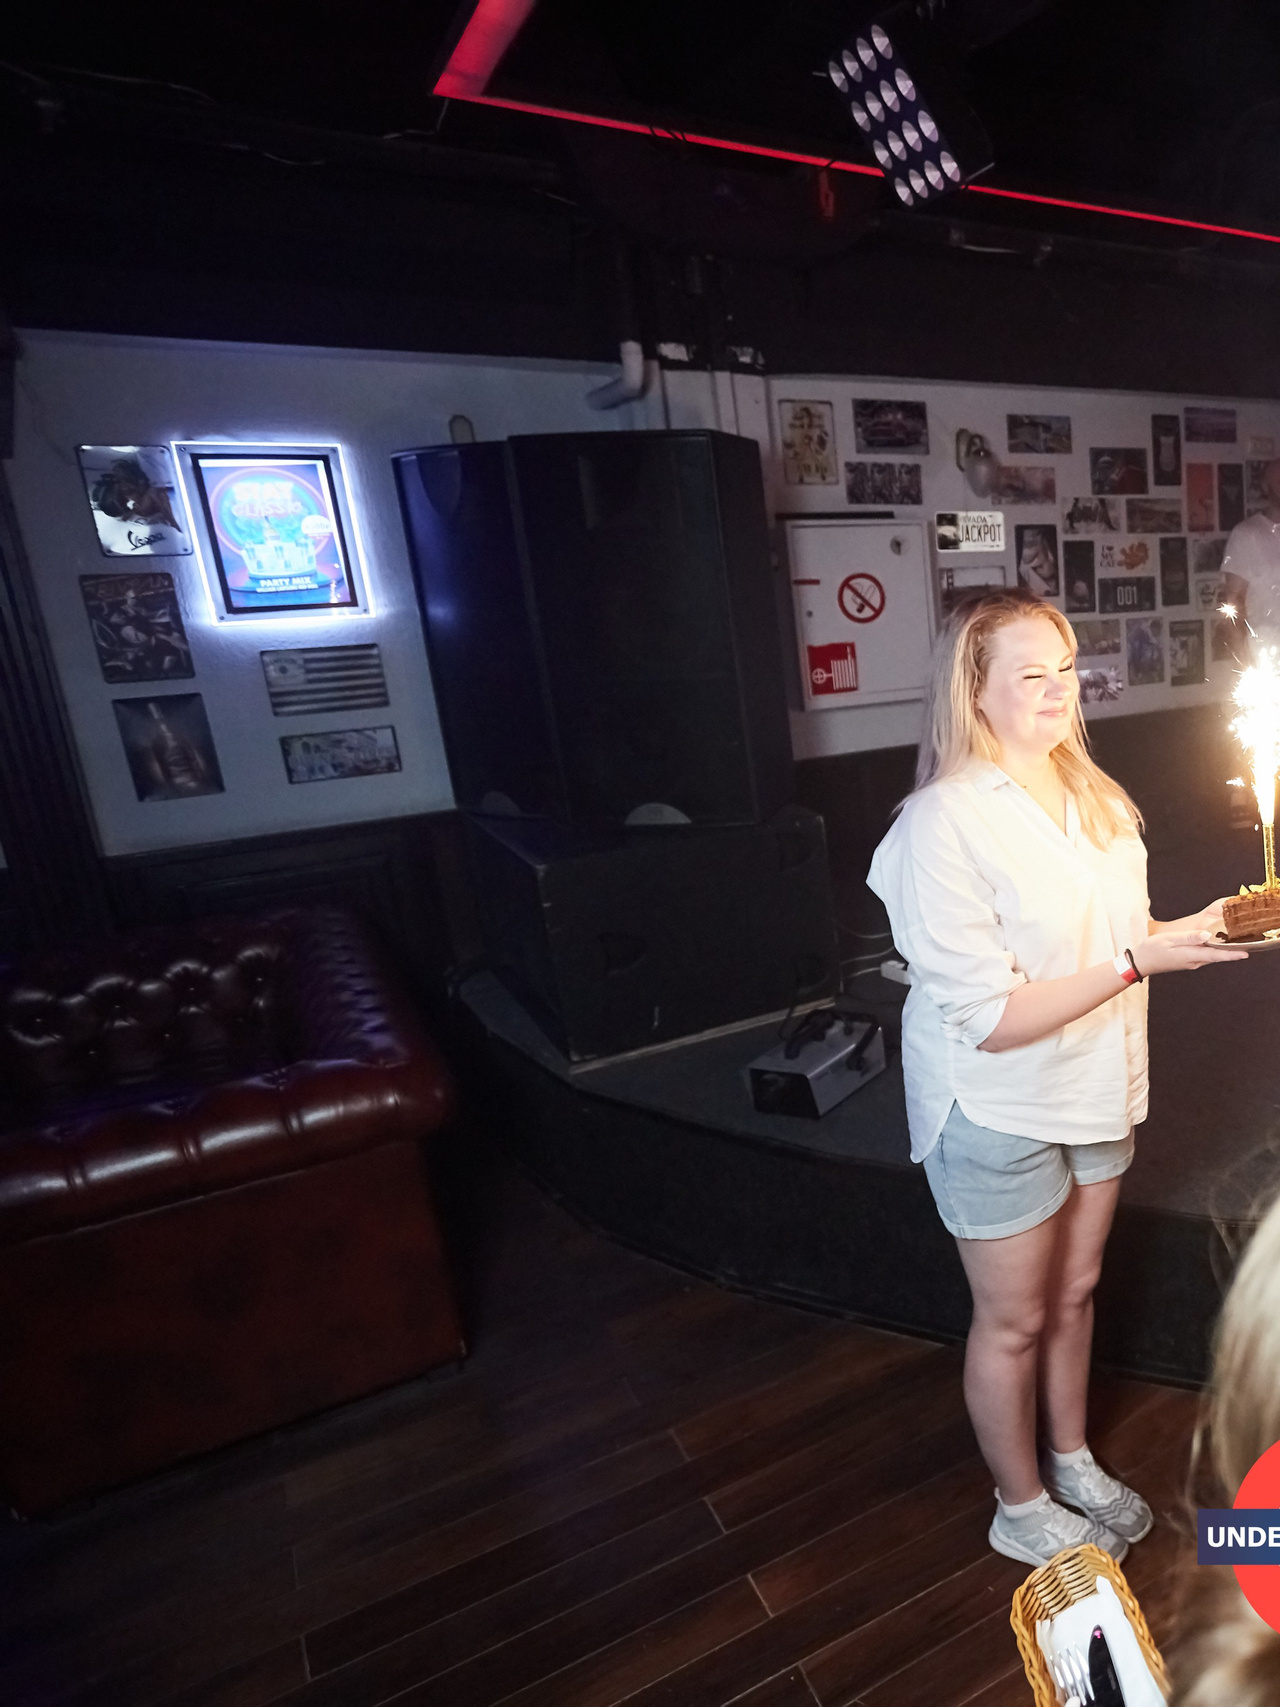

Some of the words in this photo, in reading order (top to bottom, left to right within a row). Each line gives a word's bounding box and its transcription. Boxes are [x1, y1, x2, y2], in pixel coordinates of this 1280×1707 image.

[960, 514, 987, 523] VADA
[959, 523, 1001, 543] JACKPOT
[259, 578, 291, 588] PARTY
[291, 576, 312, 585] MIX
